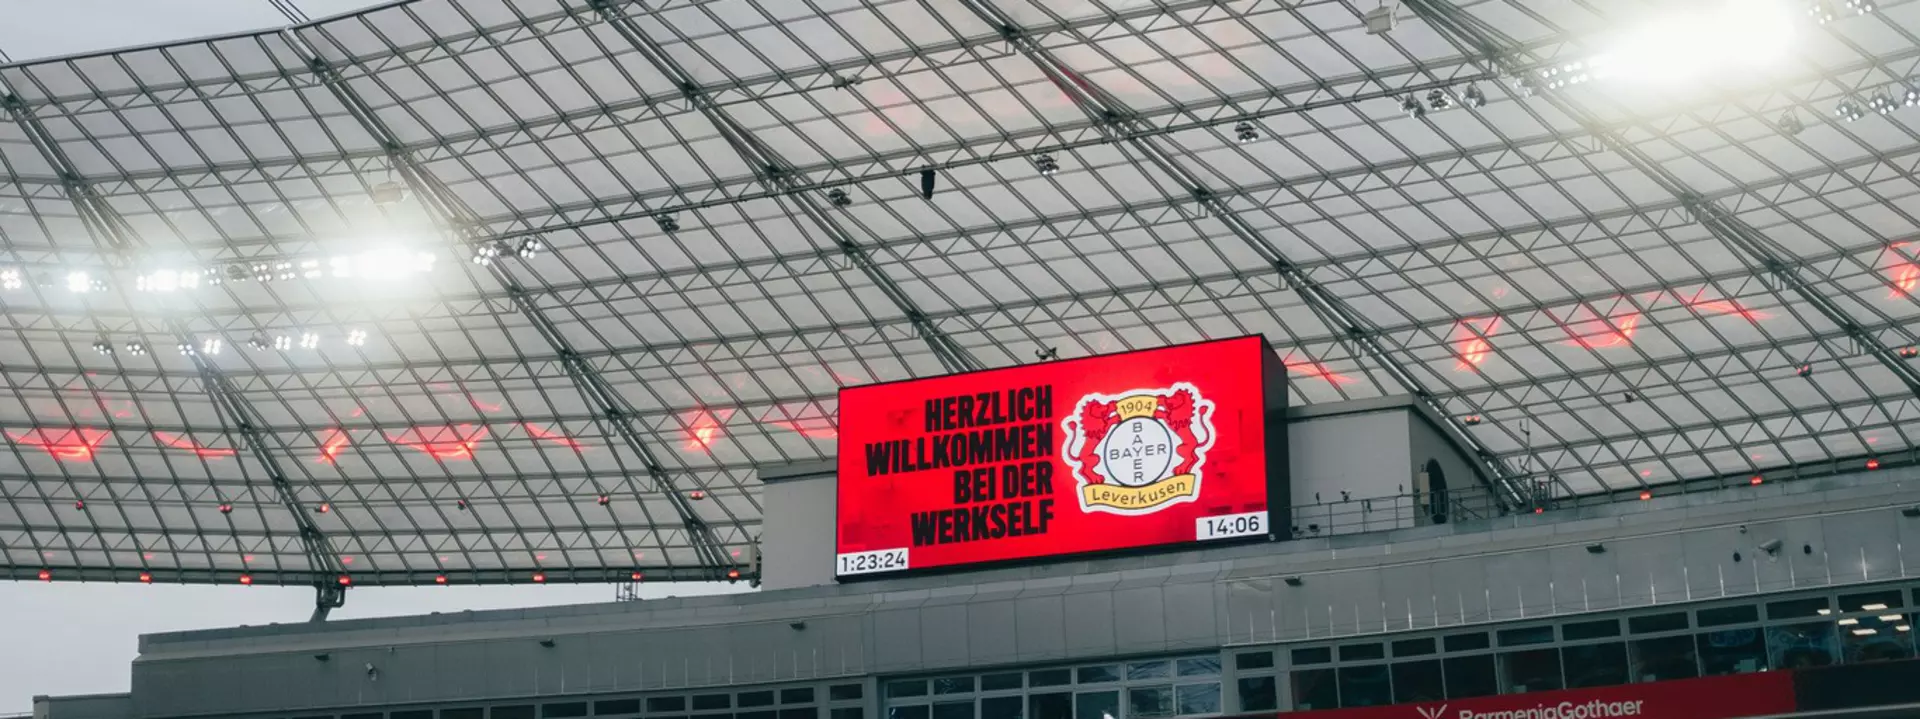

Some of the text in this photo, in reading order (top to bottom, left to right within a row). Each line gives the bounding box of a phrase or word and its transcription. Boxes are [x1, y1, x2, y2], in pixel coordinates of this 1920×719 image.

[925, 385, 1052, 432] HERZLICH
[1121, 401, 1152, 415] 1904
[865, 423, 1053, 476] WILLKOMMEN
[1109, 444, 1166, 460] BAYER
[1132, 422, 1143, 483] BAYER
[954, 461, 1053, 504] BEI DER
[1092, 481, 1186, 505] Leverkusen
[911, 499, 1054, 547] WERKSELF
[1207, 516, 1260, 536] 14:06
[842, 552, 905, 572] 1:23:24
